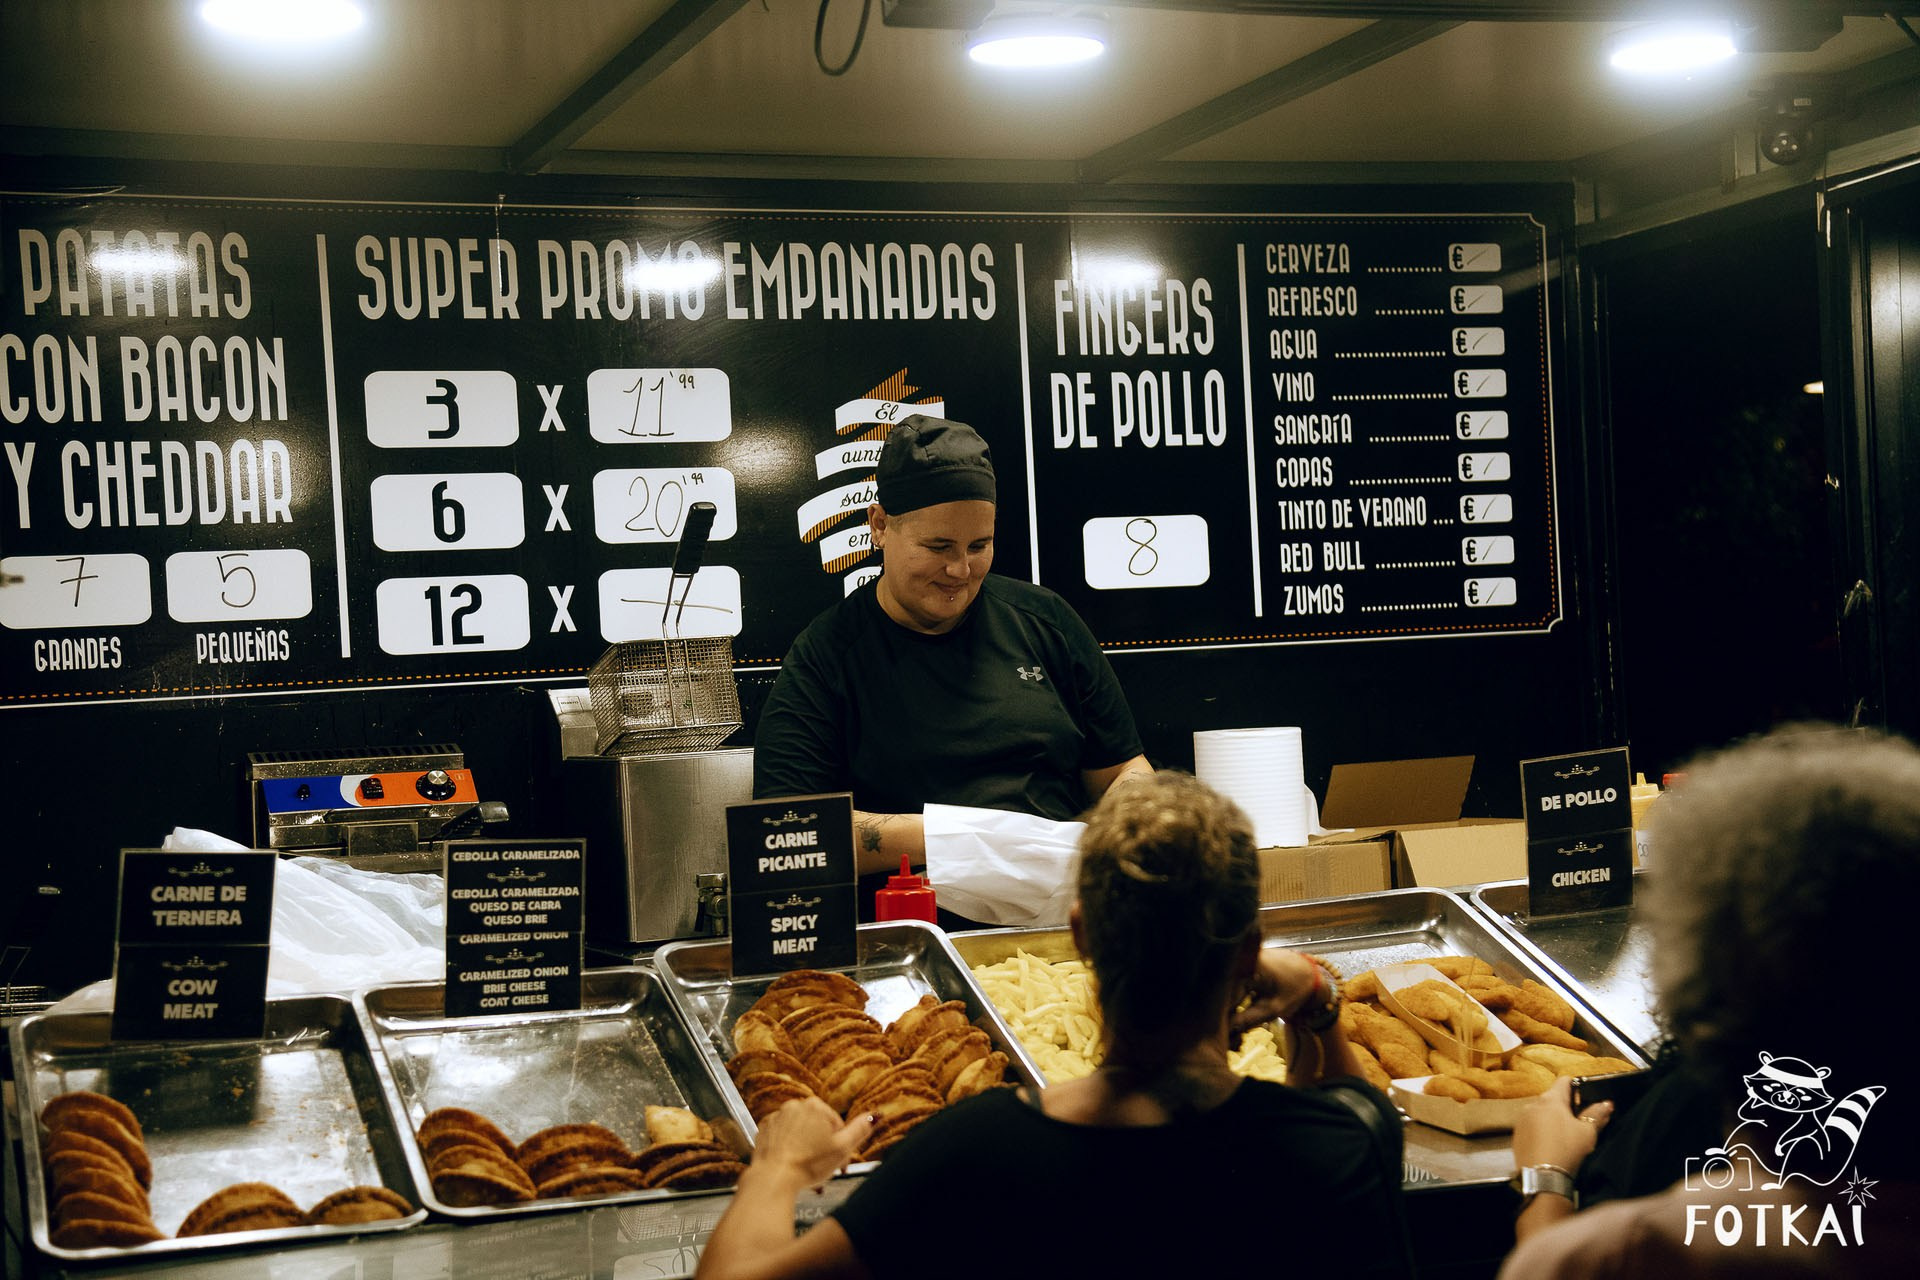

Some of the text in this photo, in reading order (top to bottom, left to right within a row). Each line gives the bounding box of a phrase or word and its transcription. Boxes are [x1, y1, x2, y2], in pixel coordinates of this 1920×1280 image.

[18, 228, 252, 320] PATATAS
[1266, 244, 1349, 274] CERVEZA
[355, 234, 997, 321] SUPER PROMO EMPANADAS
[1268, 286, 1357, 316] REFRESCO
[1054, 277, 1215, 357] FINGERS
[1270, 329, 1317, 359] AGUA
[0, 333, 288, 424] CON BACON
[1272, 372, 1314, 401] VINO
[426, 379, 566, 439] 3 X
[1051, 369, 1226, 448] DE POLLO
[1274, 414, 1352, 445] SANGRÍA
[4, 438, 293, 530] Y CHEDDAR
[1277, 457, 1332, 487] COPAS
[432, 481, 571, 543] 6 X
[1278, 499, 1326, 530] TINTO
[1332, 499, 1353, 528] DE
[1359, 496, 1426, 527] VERANO
[1126, 517, 1158, 575] 8
[1281, 543, 1312, 572] RED
[1323, 541, 1365, 571] BULL
[56, 557, 98, 607] 7
[216, 553, 256, 608] 5
[1284, 584, 1344, 615] ZUMOS
[425, 584, 577, 646] 12 X
[35, 637, 121, 671] GRANDES
[196, 627, 289, 664] PEQUEÑAS
[1541, 788, 1616, 811] DE POLLO
[765, 831, 817, 849] CARNE
[453, 850, 580, 861] CEBOLLA CARAMELIZADA
[759, 852, 826, 872] PICANTE
[1552, 868, 1610, 887] CHICKEN
[151, 886, 246, 902] CARNE DE
[452, 887, 579, 899] CEBOLLA CARAMELIZADA
[470, 901, 561, 913] QUESO DE CABRA
[153, 910, 242, 925] TERNERA
[484, 914, 547, 926] QUESO BRIE
[771, 915, 818, 932] SPICY
[460, 932, 568, 944] CARAMELIZED ONION
[773, 937, 817, 954] MEAT
[168, 980, 217, 995] COW
[460, 966, 568, 981] CARAMELIZED ONION
[483, 981, 546, 994] BRIE CHEESE
[164, 1003, 218, 1019] MEAT
[480, 994, 548, 1007] GOAT CHEESE
